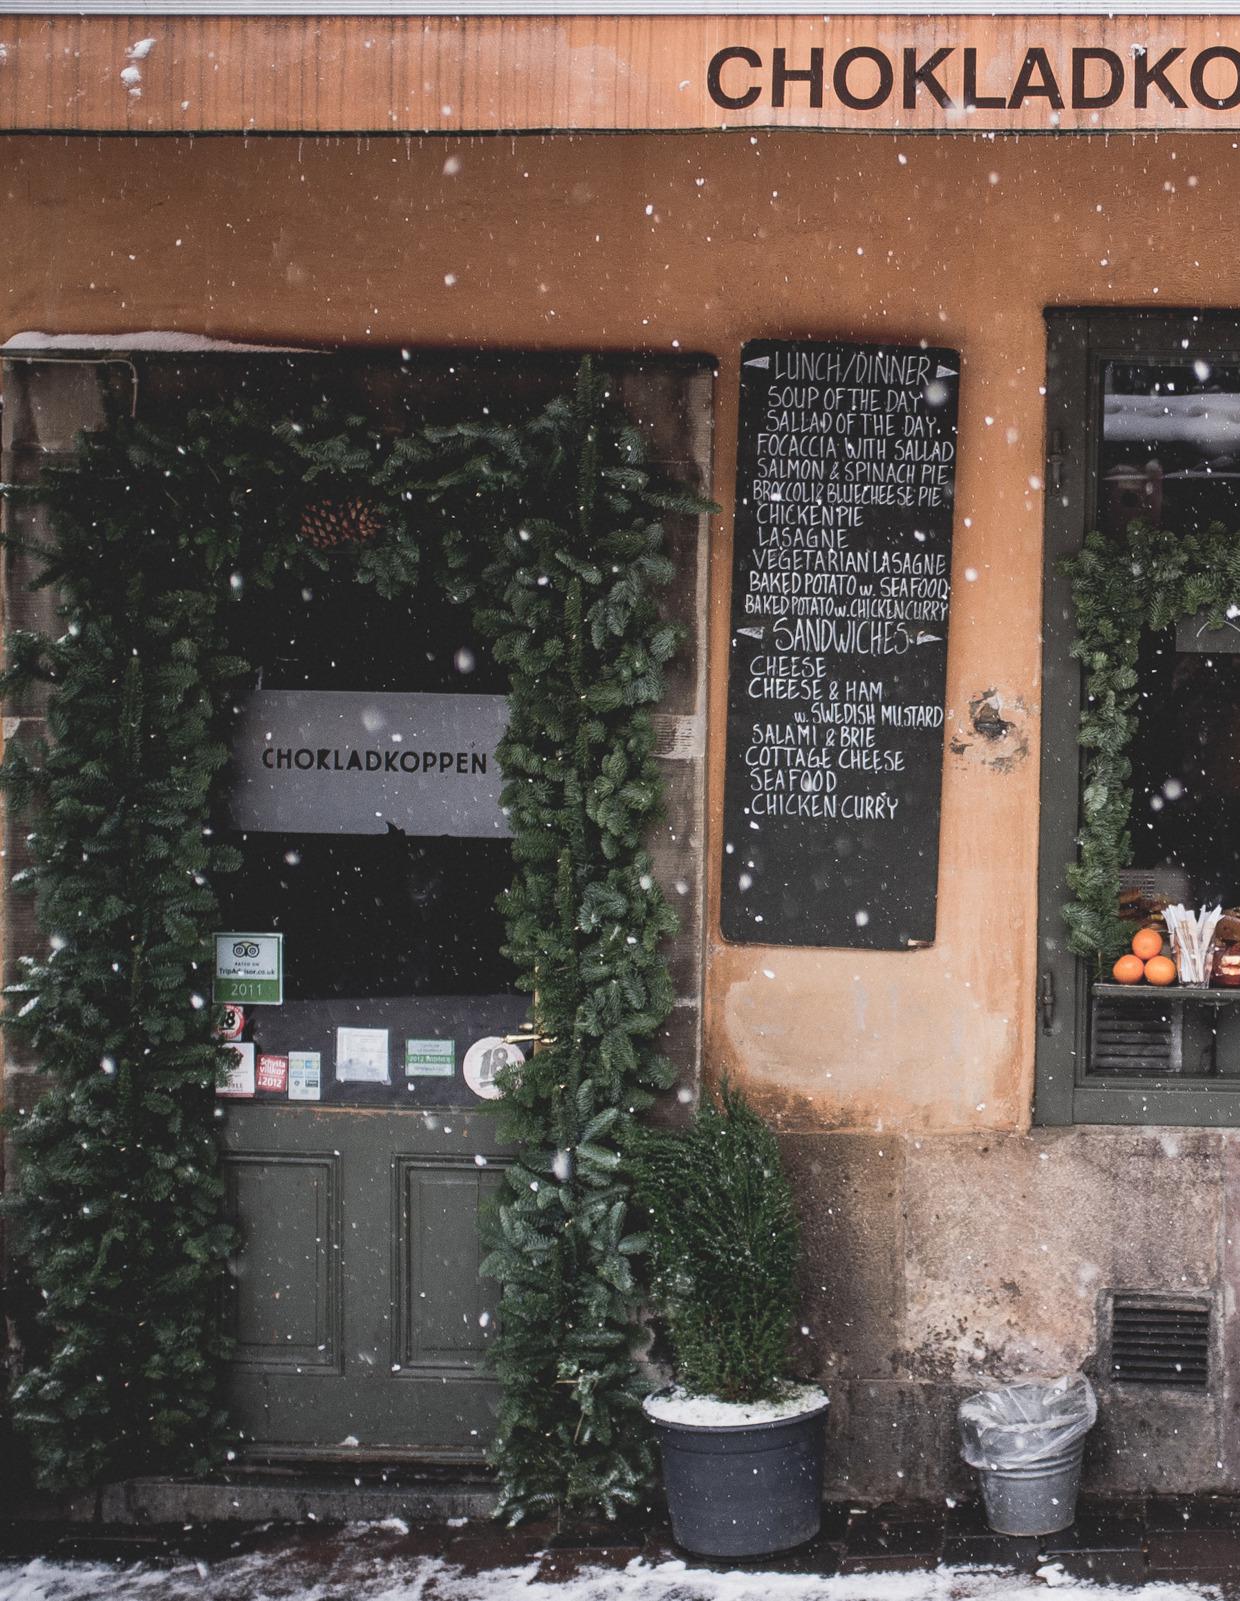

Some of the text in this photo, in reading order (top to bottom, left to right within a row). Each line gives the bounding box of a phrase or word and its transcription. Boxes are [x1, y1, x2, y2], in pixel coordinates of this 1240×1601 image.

[775, 351, 931, 385] LUNCH/DINNER
[768, 385, 923, 413] SOUP OF THE DAY
[766, 409, 832, 434] SALLAD
[836, 412, 857, 435] OF
[859, 413, 895, 436] THE
[757, 433, 954, 463] FOCACCIA WITH SALLAD
[757, 458, 949, 485] SALMON & SPINACH PIE
[918, 487, 942, 507] PIE
[756, 503, 864, 527] CHICKEN PIE
[758, 526, 849, 548] LASAGNE
[752, 549, 946, 575] VEGETARIAN LASAGNE
[750, 570, 801, 595] BAKED
[804, 573, 857, 595] POTATO
[859, 584, 876, 597] w.
[745, 594, 789, 615] BAKED
[791, 596, 835, 616] POTATO
[850, 599, 901, 619] CHICKEN
[903, 600, 948, 621] CURRY
[773, 617, 910, 654] SANDWICHES
[750, 656, 827, 678] CHEESE
[748, 677, 883, 702] CHEESE & HAM
[794, 702, 944, 727] w. SWEDISH MUSTARD
[752, 724, 876, 748] SALAMI & BRIE
[262, 748, 487, 774] CHOKLADKOPPEN
[746, 746, 905, 771] COTTAGE CHEESE
[752, 793, 899, 820] CHICKEN CURRY
[231, 983, 262, 997] 2011
[480, 1048, 508, 1079] 18
[262, 1077, 282, 1088] 2012
